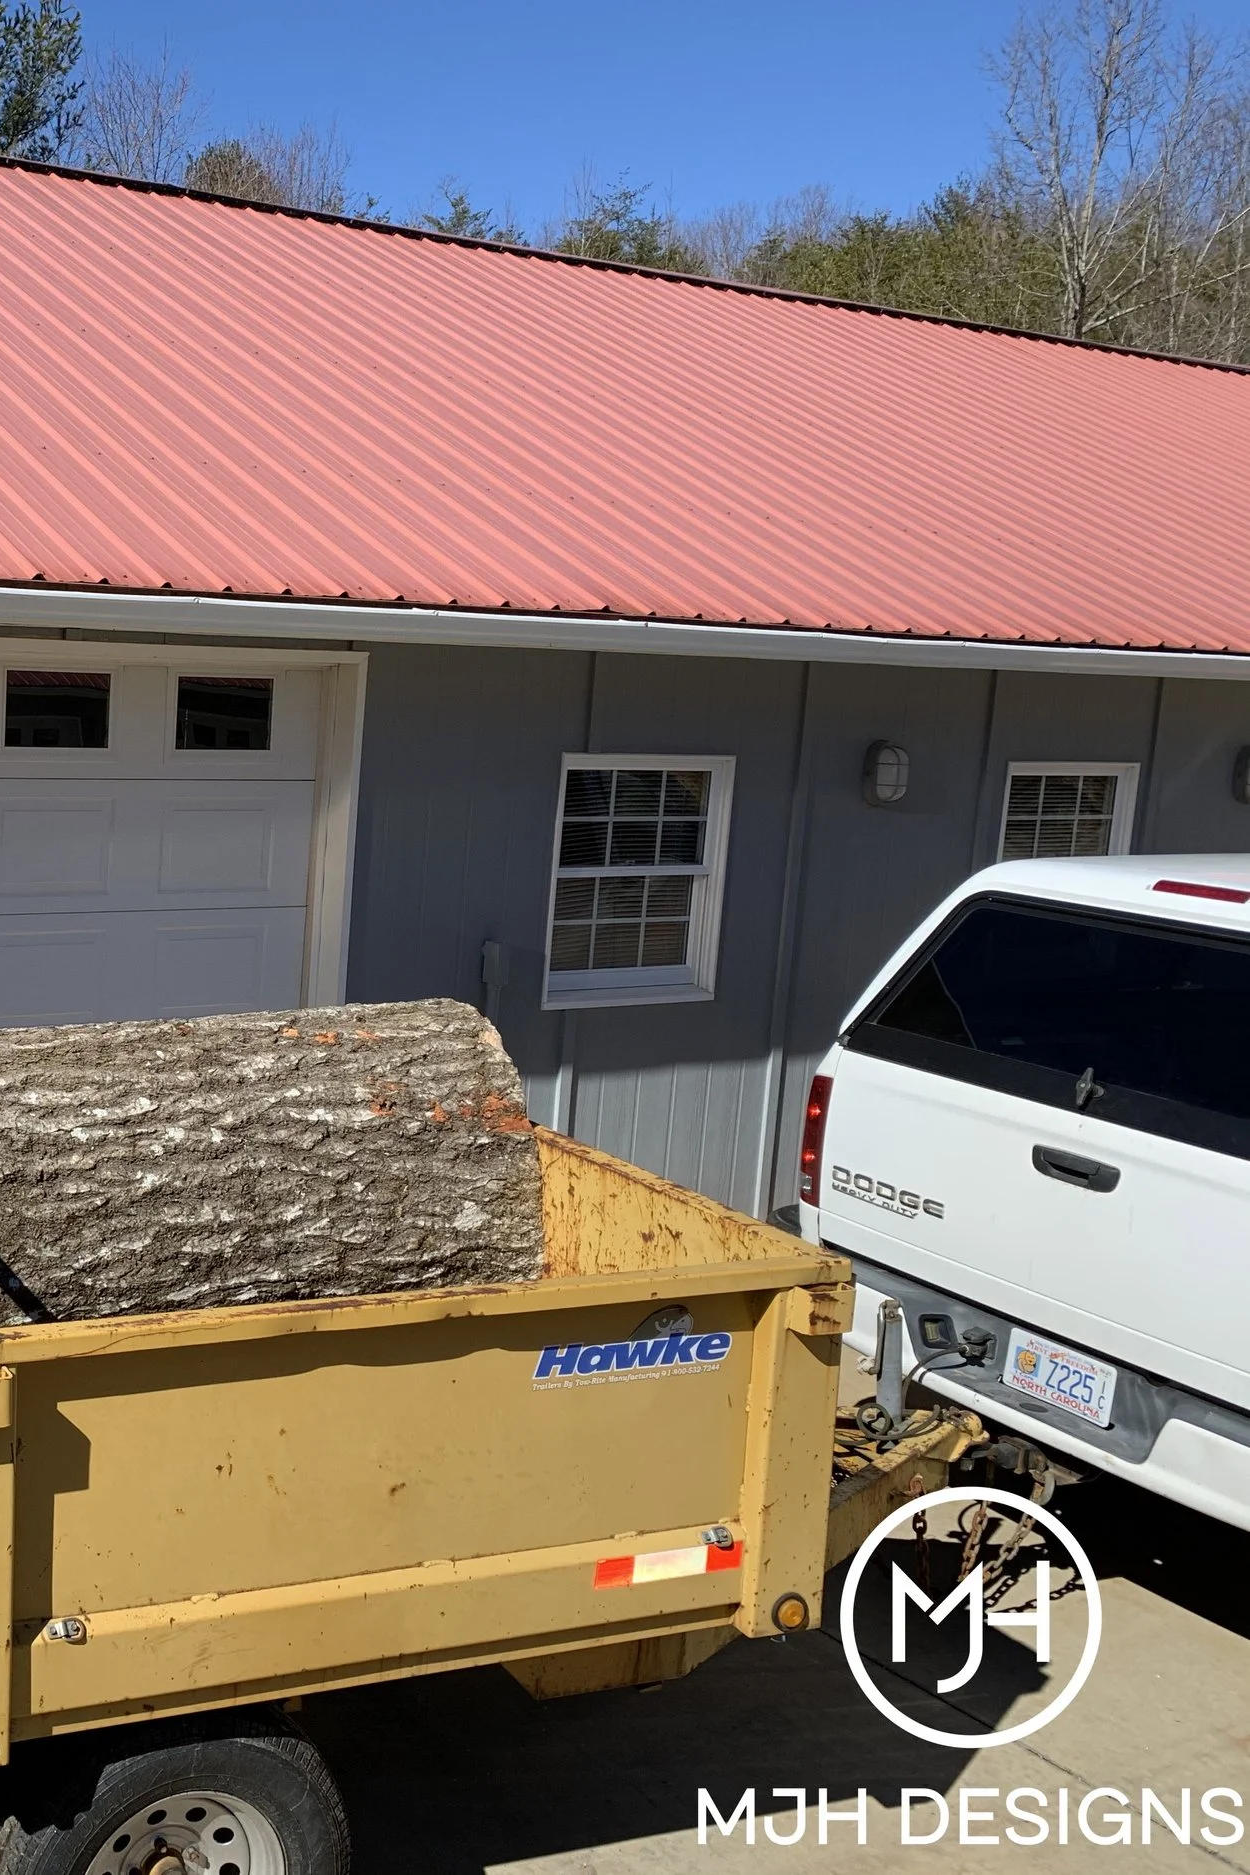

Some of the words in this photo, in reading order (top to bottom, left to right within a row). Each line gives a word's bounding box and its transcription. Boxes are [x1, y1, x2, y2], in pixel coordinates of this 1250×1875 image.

[832, 1165, 944, 1220] DODGE
[881, 1200, 918, 1217] DUTY
[532, 1331, 733, 1379] Hawke
[1012, 1374, 1047, 1396] NORTH
[1050, 1391, 1100, 1418] CAROLINA
[1045, 1360, 1095, 1404] Z225
